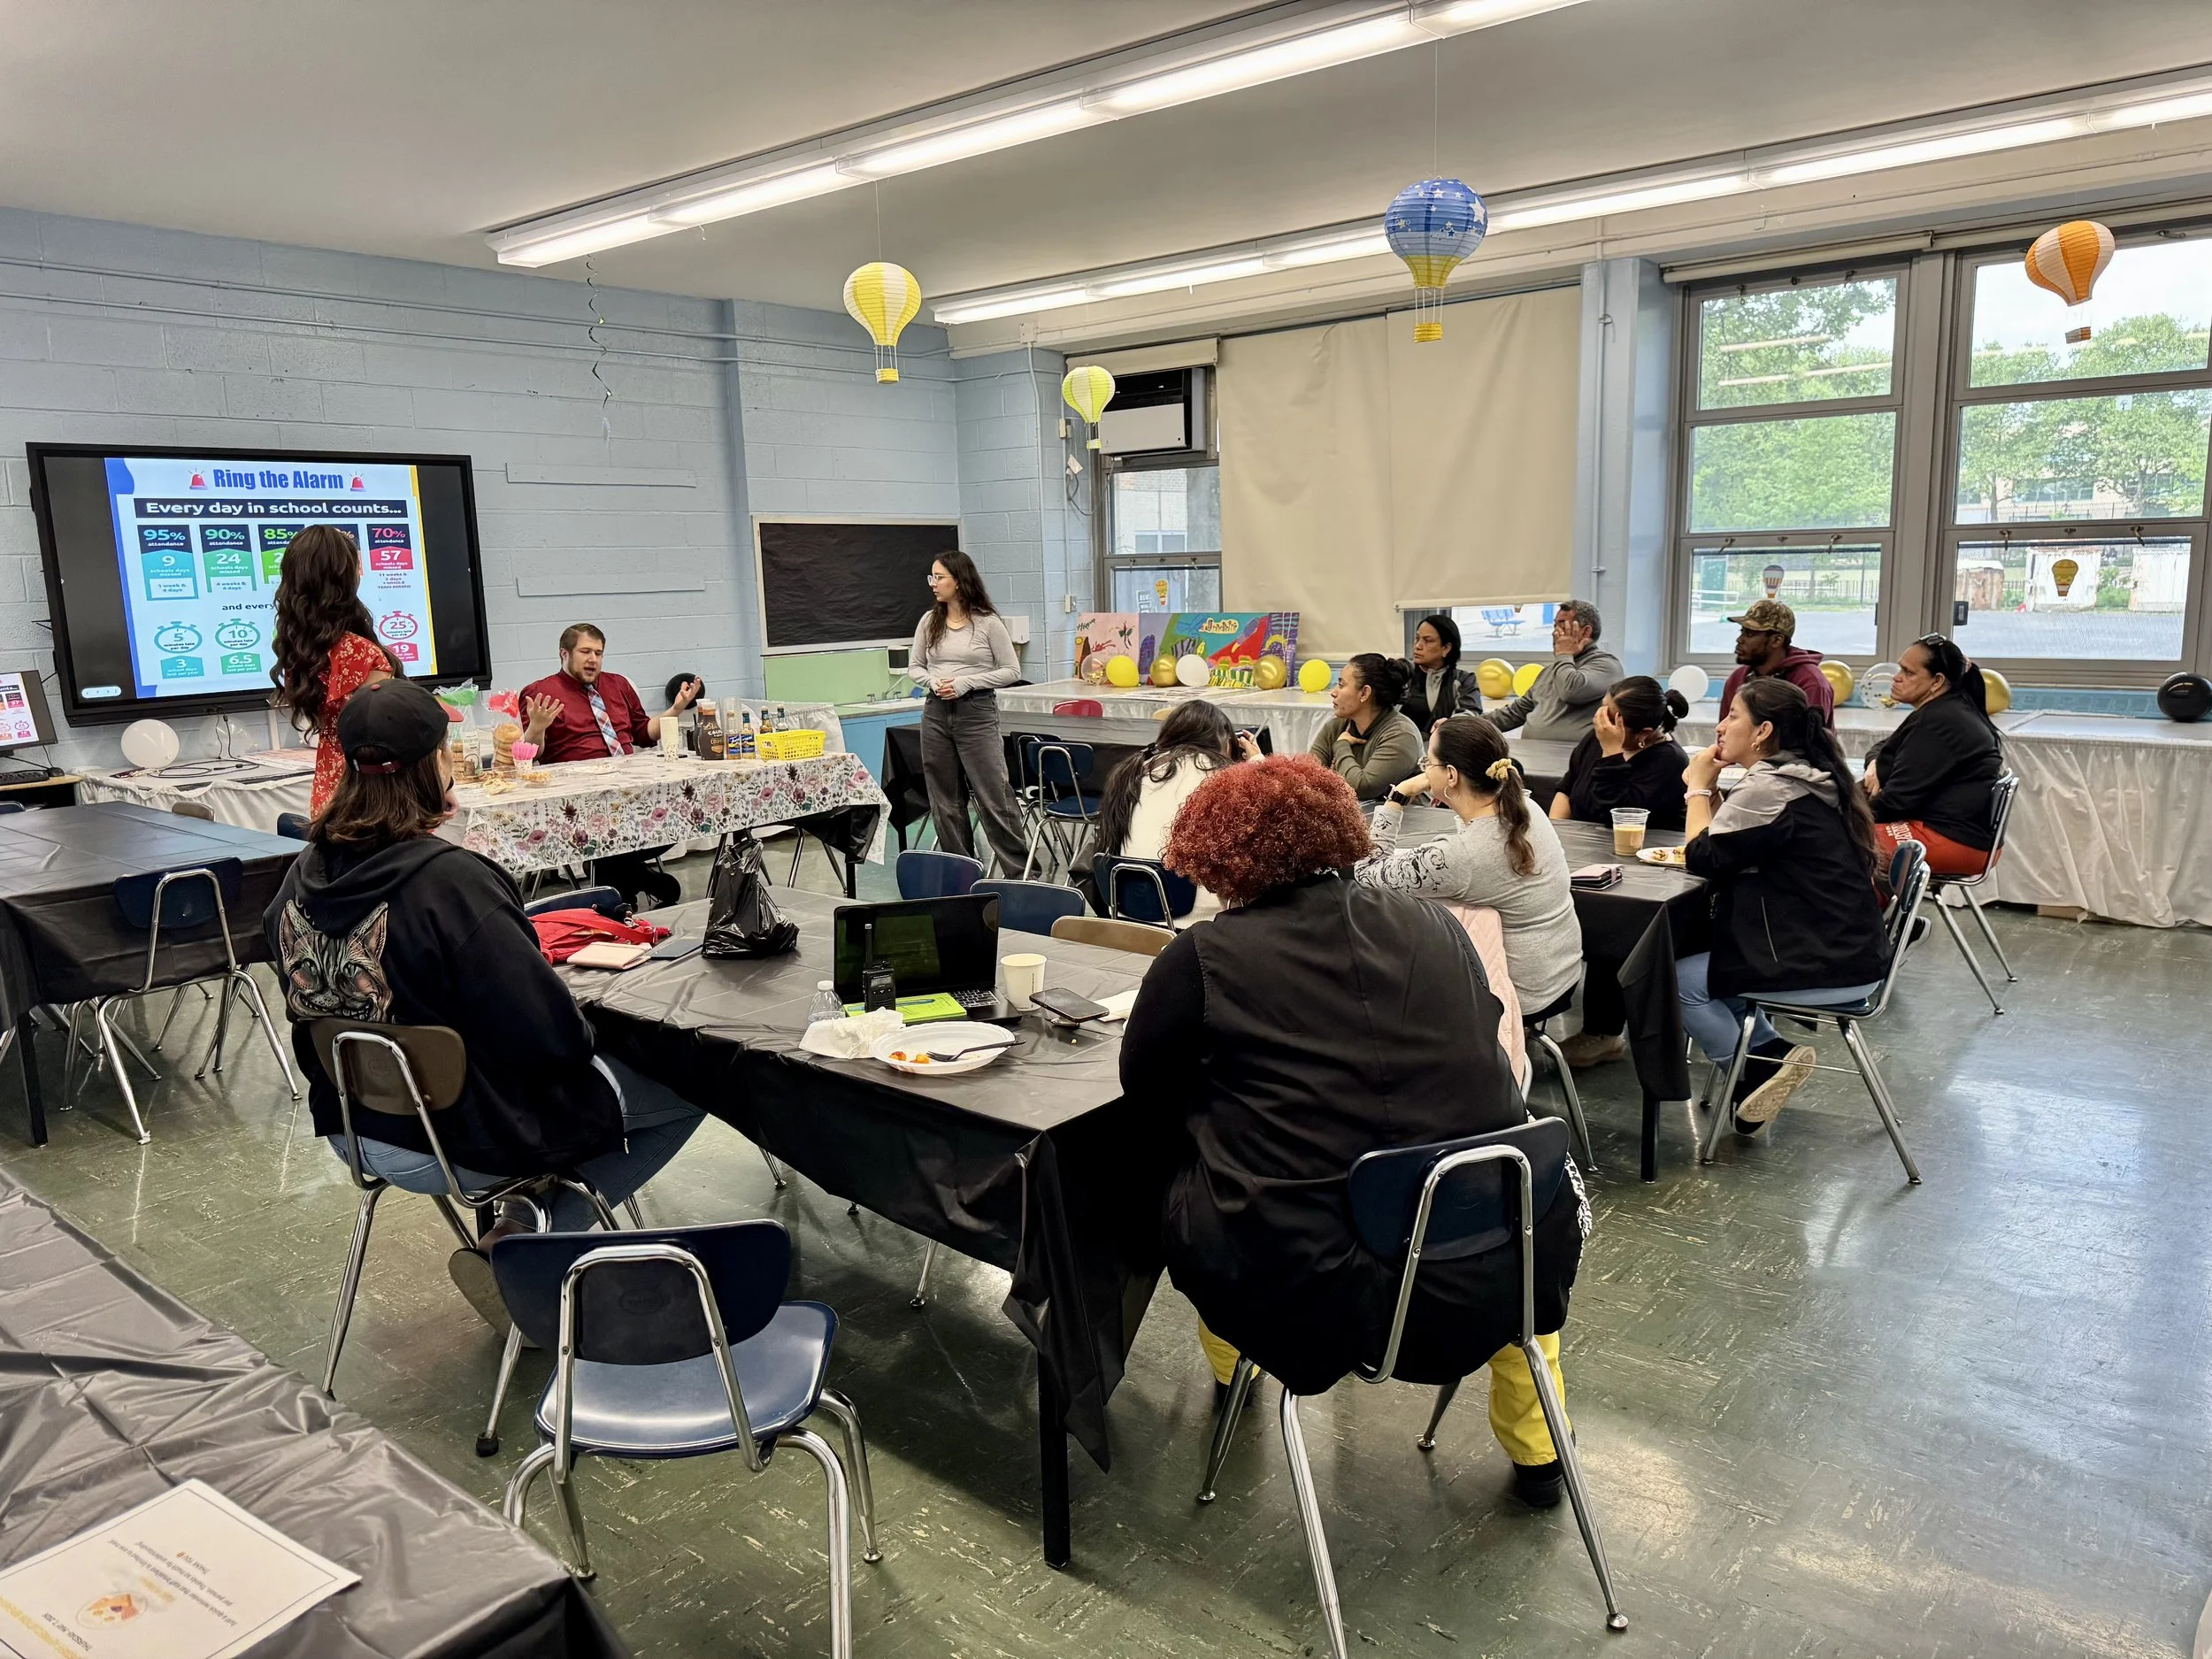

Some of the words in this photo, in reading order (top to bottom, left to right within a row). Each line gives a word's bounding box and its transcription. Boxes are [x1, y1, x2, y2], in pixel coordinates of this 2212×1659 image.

[213, 469, 256, 489] Ring
[259, 470, 288, 488] the
[293, 471, 343, 488] Alarm
[146, 503, 204, 515] Every
[209, 502, 242, 515] day
[248, 502, 265, 513] in
[269, 503, 328, 513] school
[332, 503, 402, 514] counts...
[143, 529, 186, 541] 95%
[205, 529, 245, 540] 90%
[372, 527, 405, 538] 70%
[162, 555, 175, 566] 9
[216, 553, 242, 565] 24
[273, 552, 284, 564] 2
[380, 550, 402, 561] 57
[174, 633, 183, 642] 5
[228, 629, 248, 639] 10
[393, 644, 410, 653] 19
[176, 658, 187, 668] 3
[229, 655, 253, 664] 6.5
[130, 1553, 148, 1567] limited
[150, 1566, 172, 1583] breakfast
[189, 1577, 206, 1590] Thanks
[188, 1593, 211, 1608] reminder
[209, 1607, 224, 1617] quick
